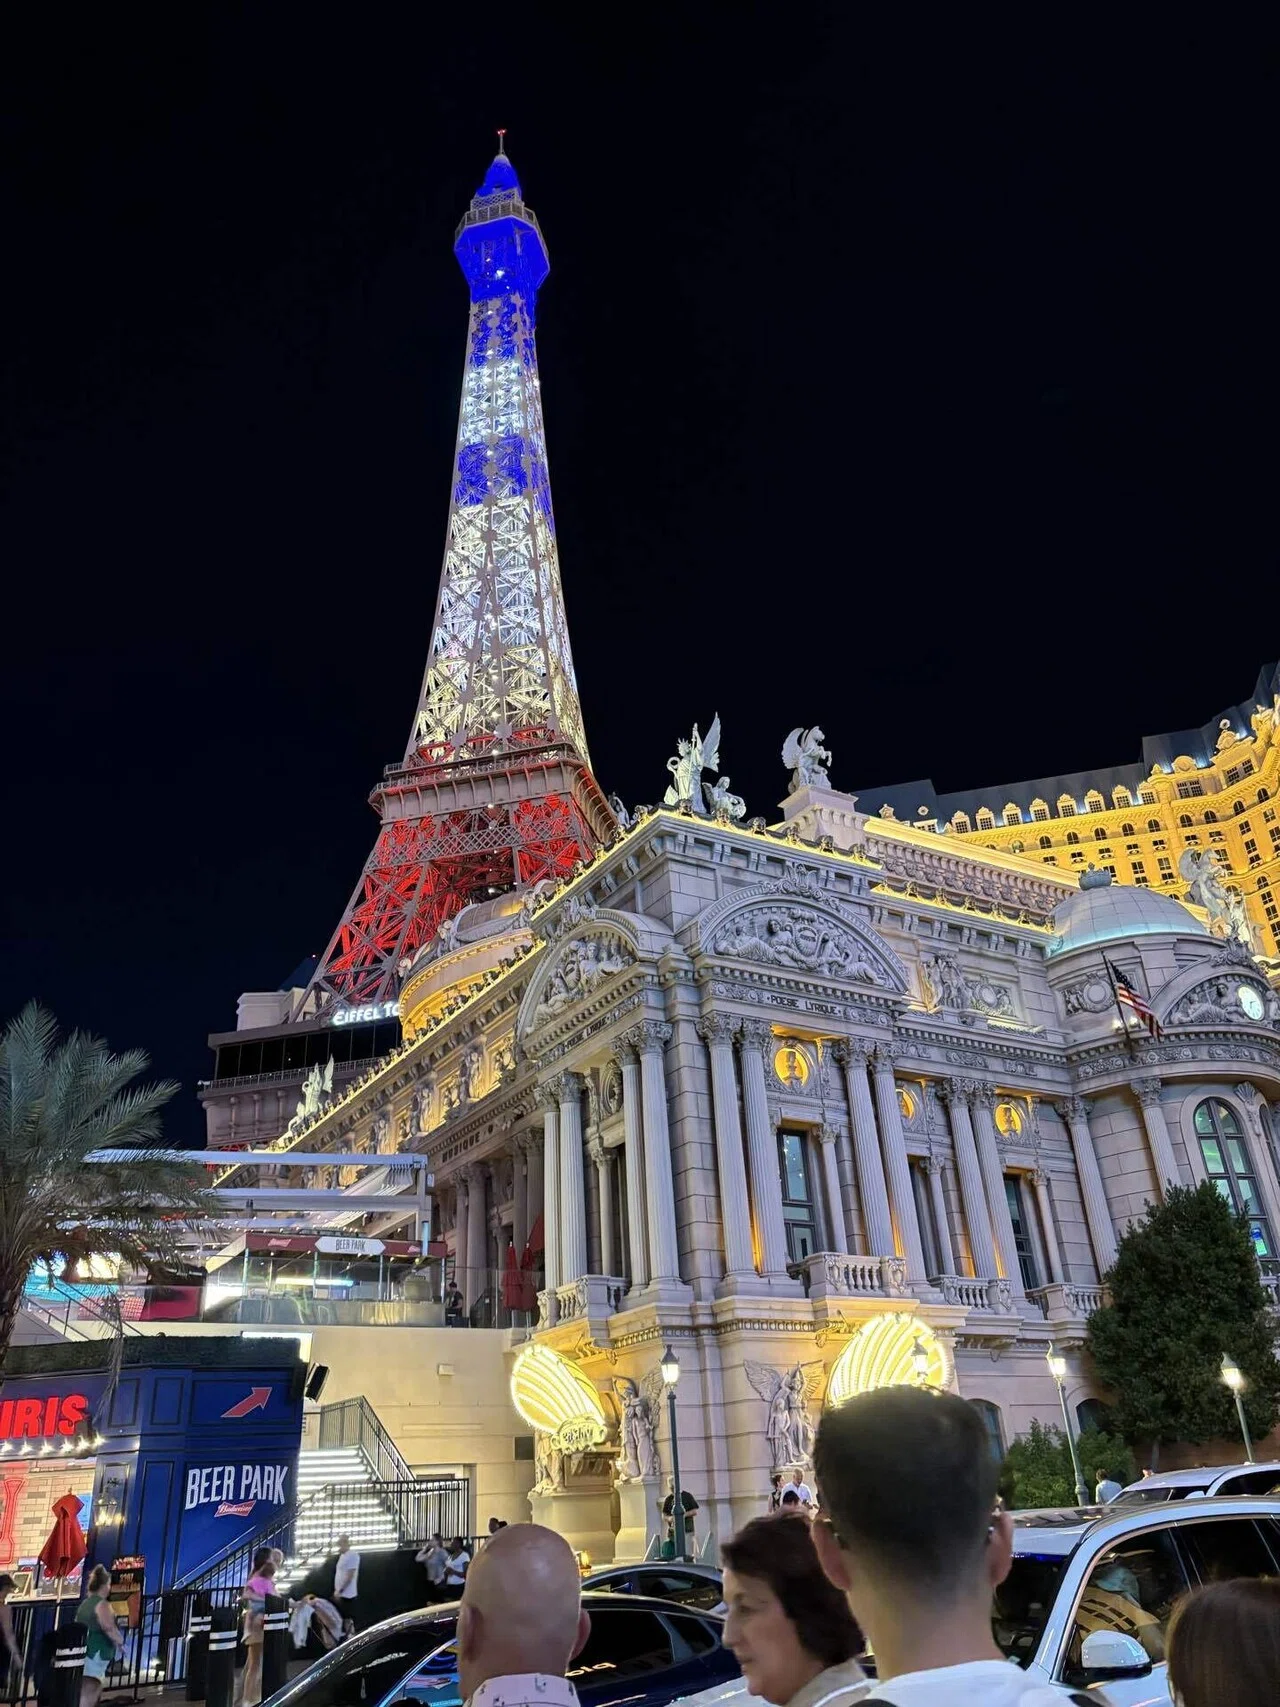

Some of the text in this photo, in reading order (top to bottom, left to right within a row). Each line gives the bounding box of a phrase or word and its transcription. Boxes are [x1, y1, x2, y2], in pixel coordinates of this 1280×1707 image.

[332, 1006, 382, 1026] EIFFEL
[335, 1239, 366, 1251] BEER PARK
[184, 1464, 290, 1510] BEER PARK
